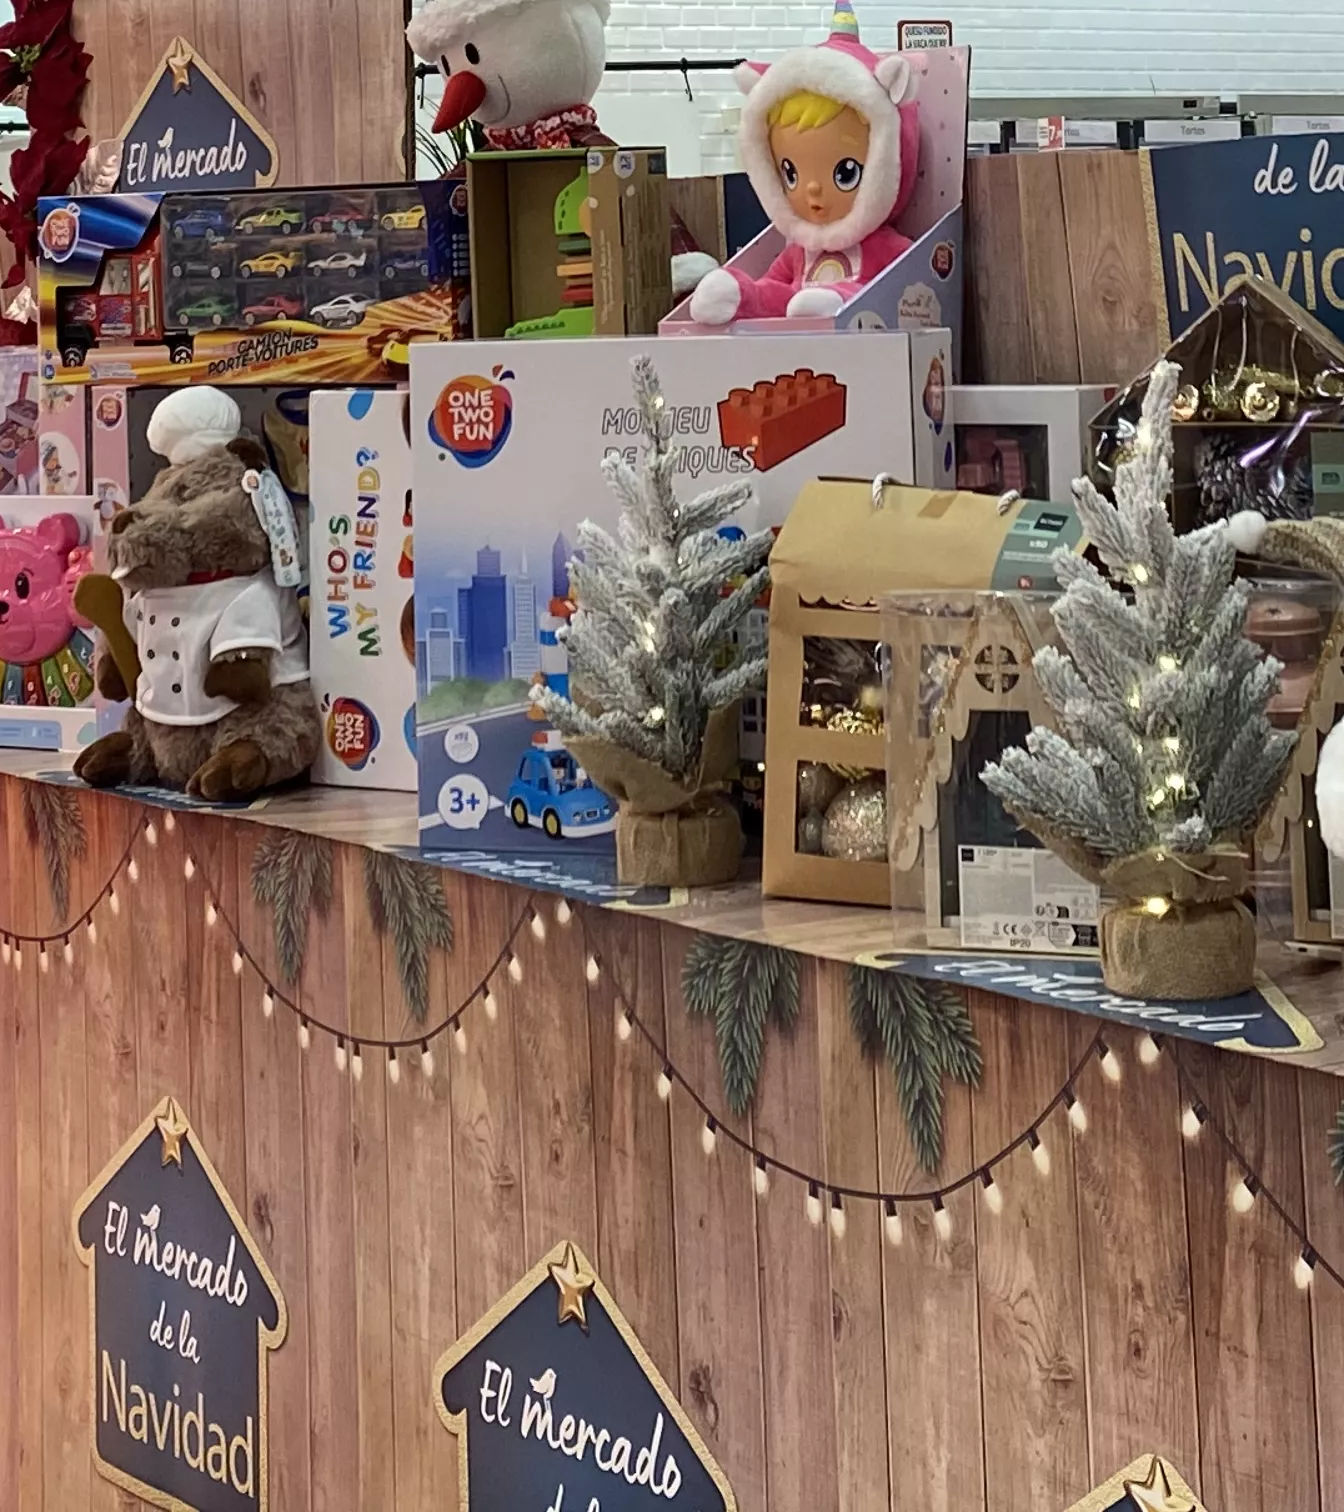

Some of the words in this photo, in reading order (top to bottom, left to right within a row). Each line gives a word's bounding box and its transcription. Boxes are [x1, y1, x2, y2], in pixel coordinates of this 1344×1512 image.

[127, 142, 148, 186] El
[152, 118, 248, 182] mercado
[1254, 143, 1298, 196] de
[207, 335, 320, 376] PORTE-VOITURES
[238, 327, 293, 354] CAMION
[448, 388, 494, 407] ONE
[448, 407, 494, 423] TWO
[453, 422, 494, 440] FUN
[602, 407, 648, 436] MO
[674, 445, 756, 479] IQUES
[352, 446, 382, 590] FRIEND?
[327, 514, 352, 639] WHO'S
[356, 602, 383, 658] MY
[335, 712, 345, 751] ONE
[345, 712, 355, 752] TWO
[353, 714, 365, 749] FUN
[449, 786, 481, 813] 3+
[1010, 939, 1031, 948] IP20
[104, 1200, 129, 1257] El
[133, 1225, 248, 1307] mercado
[149, 1300, 175, 1349] de
[179, 1310, 201, 1364] la
[101, 1349, 255, 1499] Navidad
[479, 1359, 512, 1427] El
[519, 1391, 683, 1500] mercado
